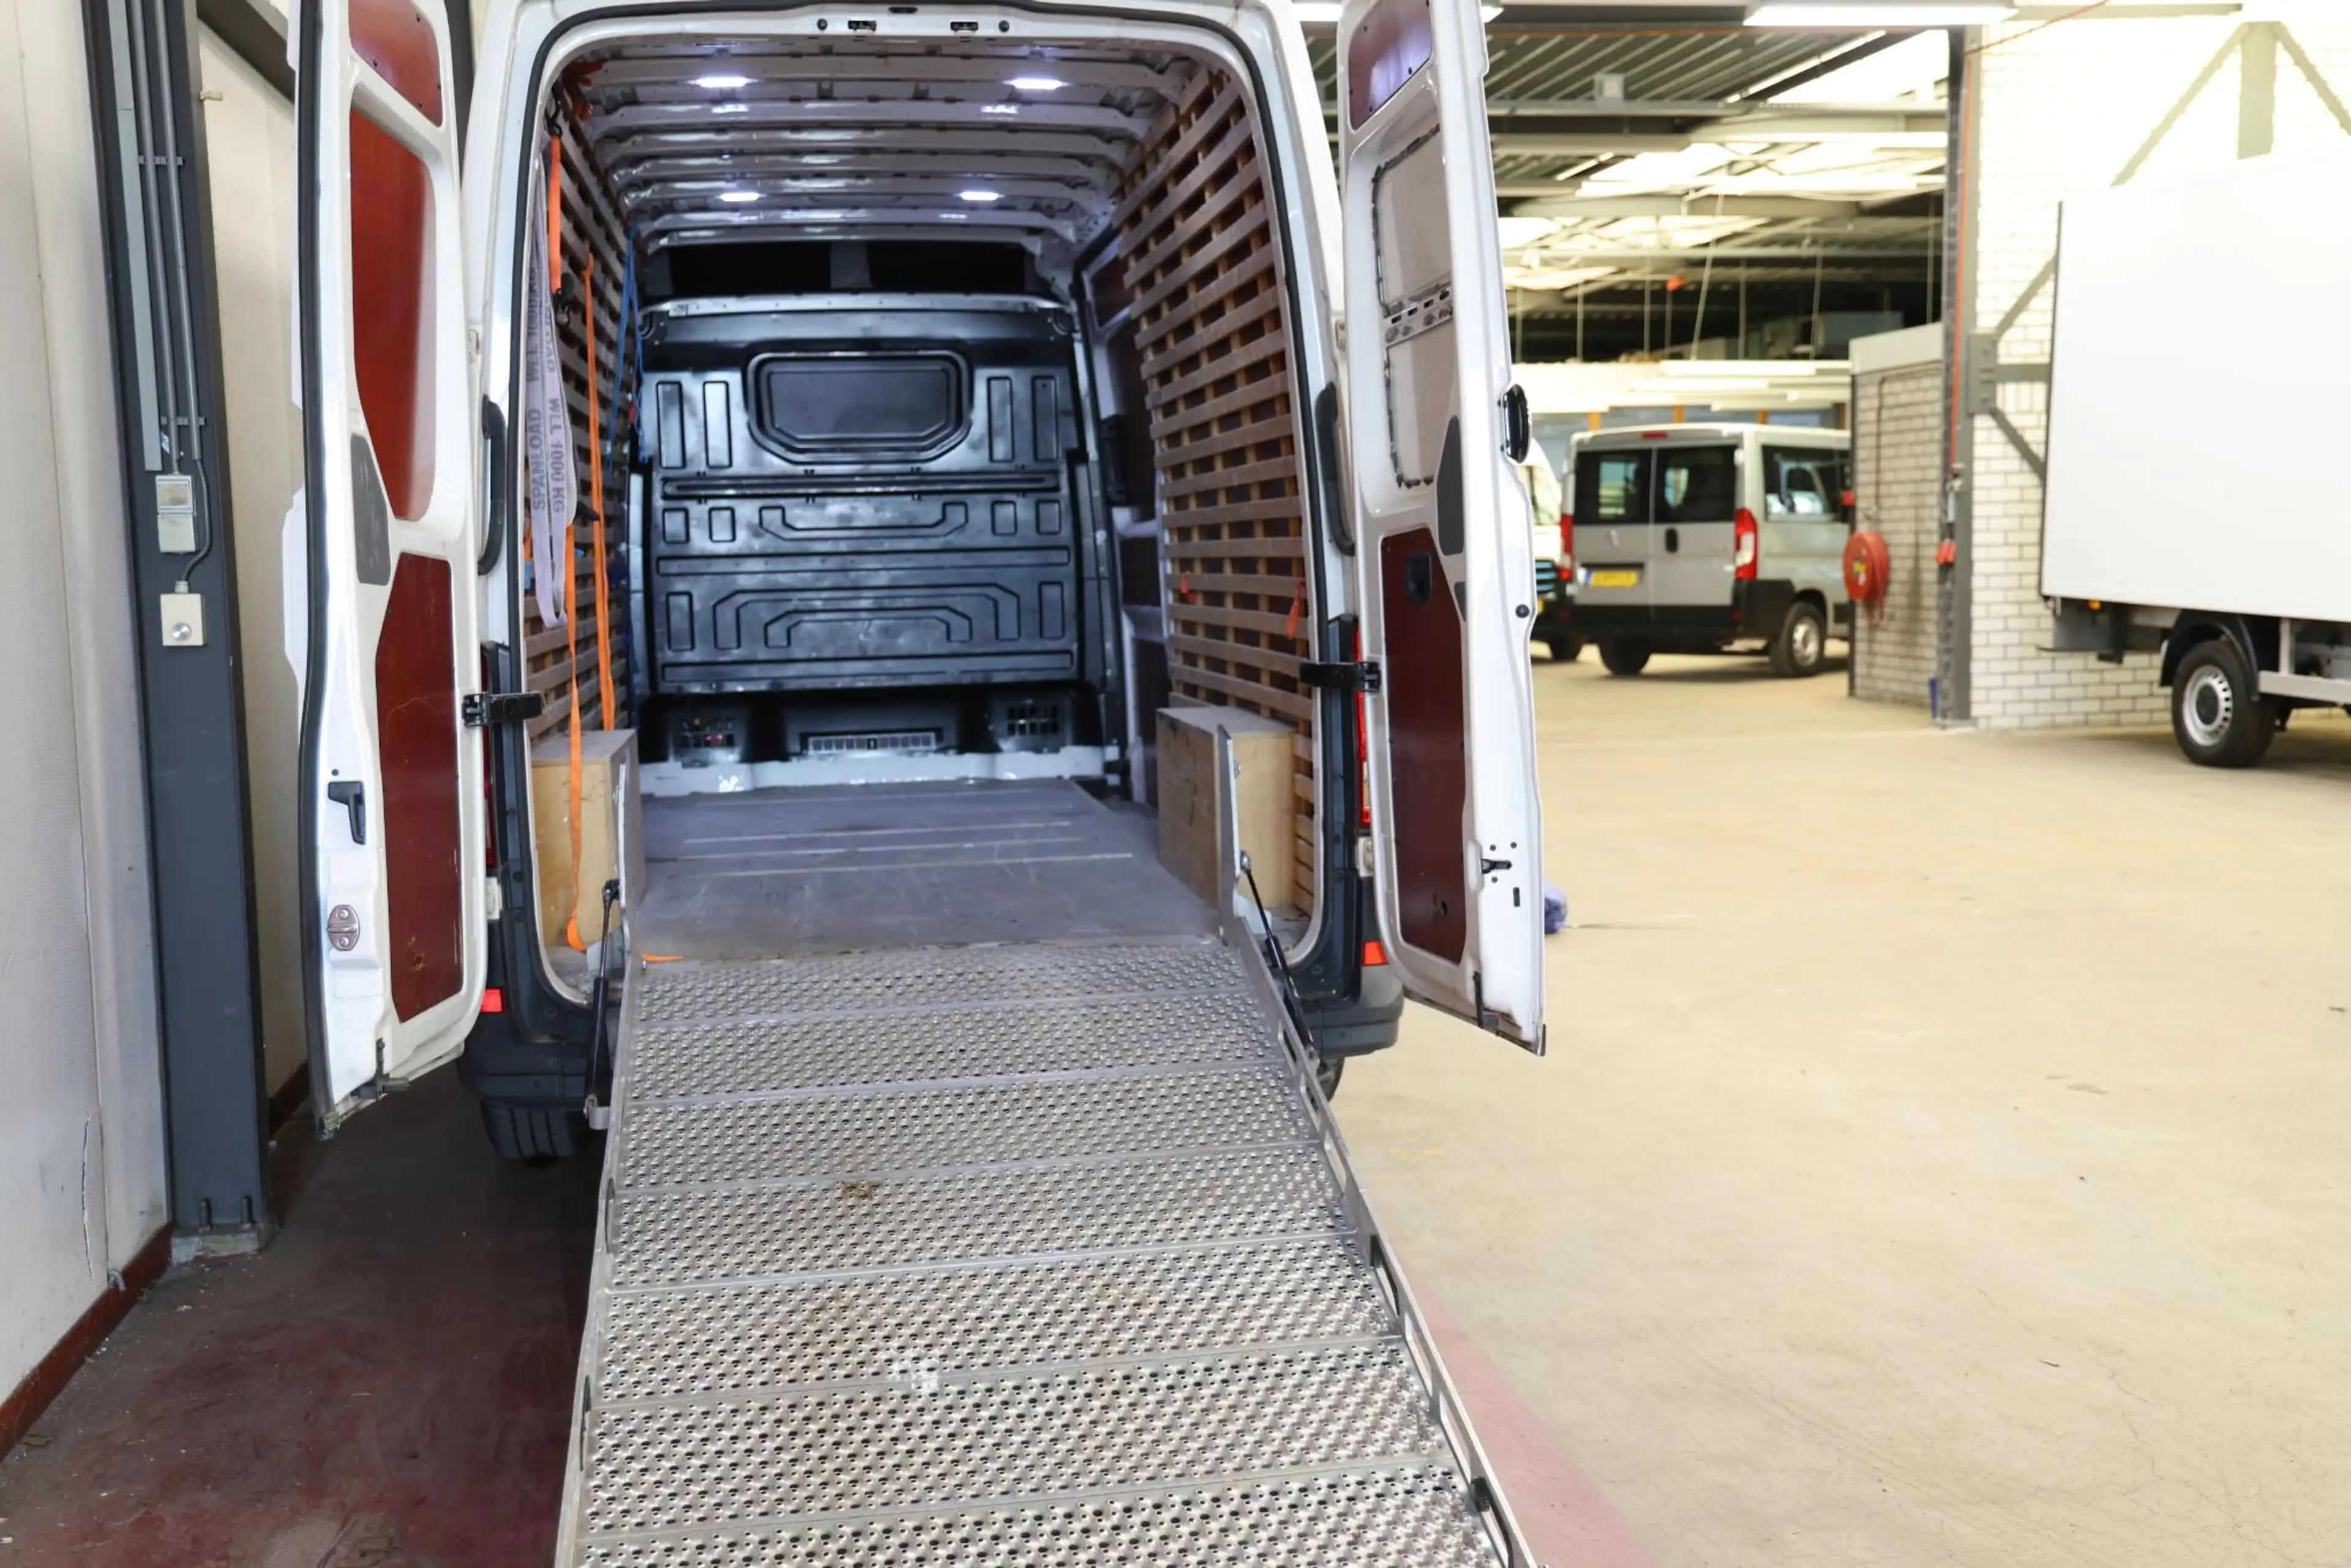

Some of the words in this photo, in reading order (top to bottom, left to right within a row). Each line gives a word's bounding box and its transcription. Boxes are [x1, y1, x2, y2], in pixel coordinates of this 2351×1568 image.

[549, 399, 562, 435] WLL
[528, 408, 546, 511] SPANLOAD
[550, 439, 564, 481] 1000
[552, 487, 565, 513] KG
